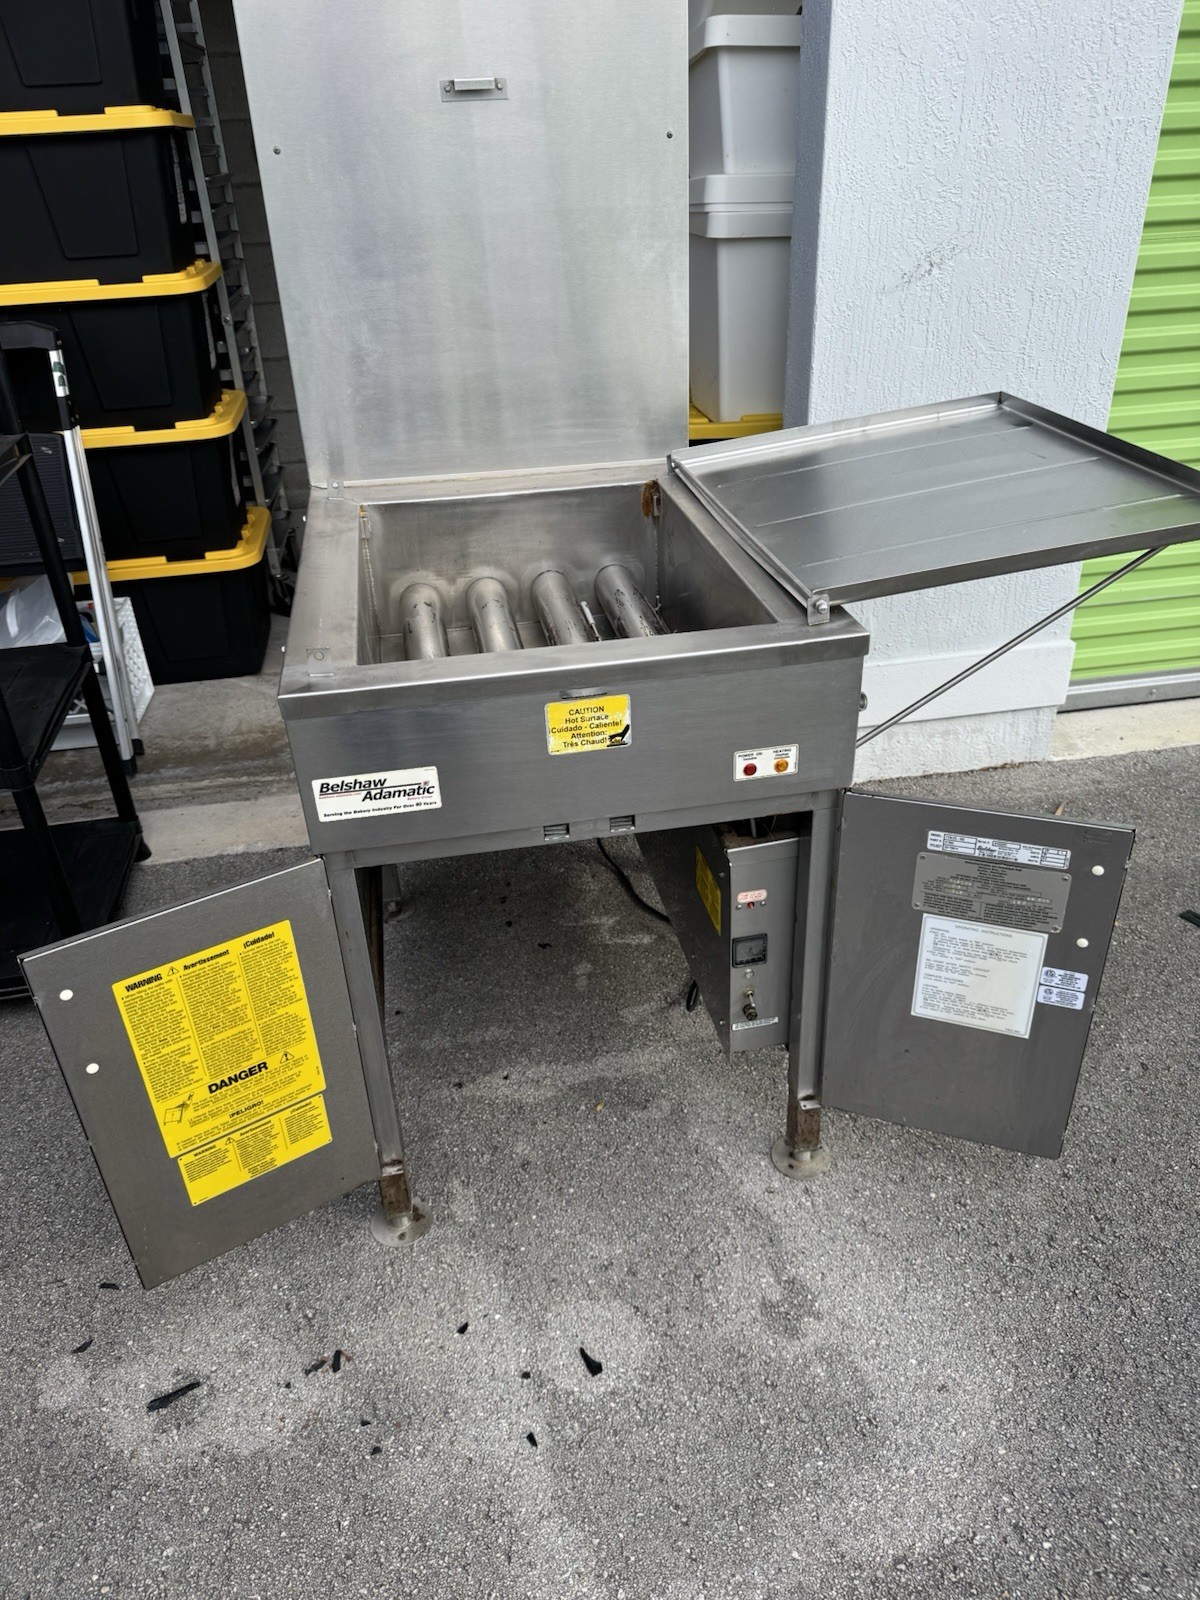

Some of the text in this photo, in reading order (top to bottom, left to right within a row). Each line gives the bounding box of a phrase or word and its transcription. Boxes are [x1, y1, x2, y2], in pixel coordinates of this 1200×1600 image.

[569, 706, 604, 715] CAUTION
[551, 726, 582, 734] Cuidado
[589, 720, 622, 729] Caliente!
[571, 730, 607, 739] Attention:
[319, 778, 387, 793] Belshaw
[362, 784, 435, 802] Adamatic
[125, 973, 163, 993] WARNING
[207, 1061, 269, 1094] DANGER
